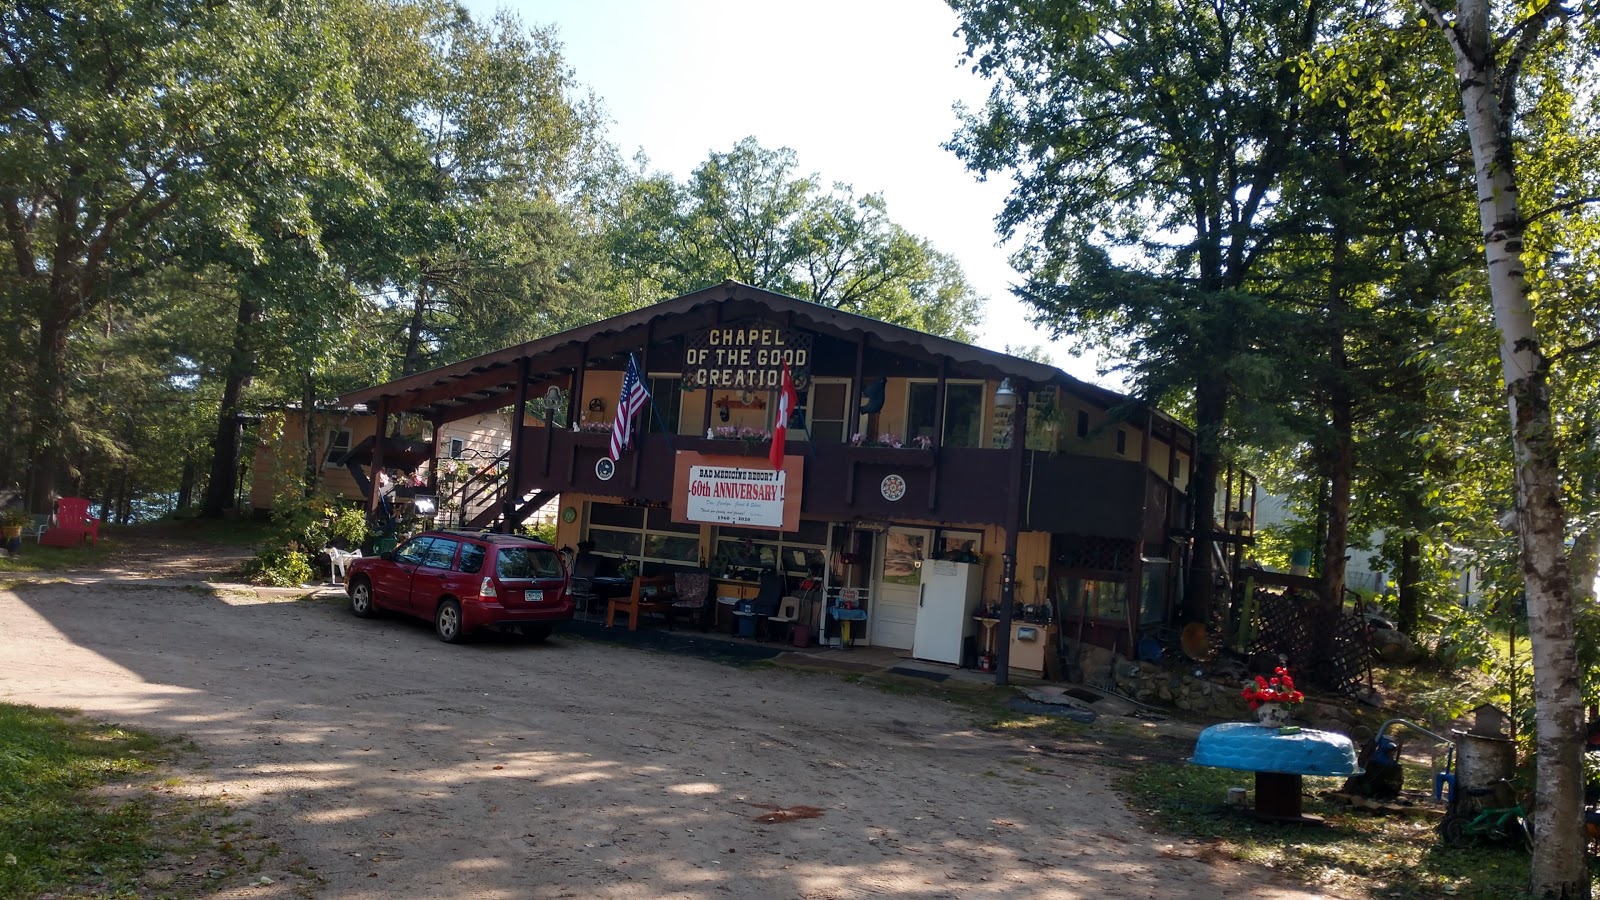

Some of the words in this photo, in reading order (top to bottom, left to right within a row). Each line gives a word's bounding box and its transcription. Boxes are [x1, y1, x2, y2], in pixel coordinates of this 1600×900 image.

[709, 329, 785, 345] CHAPEL
[686, 349, 709, 365] OF
[716, 349, 751, 366] THE
[757, 349, 807, 366] GOOD
[699, 469, 713, 479] BAD
[714, 470, 747, 480] MEDICINE
[748, 472, 773, 481] RESORT
[691, 480, 711, 497] 60th
[713, 482, 778, 501] ANNIVERSARY
